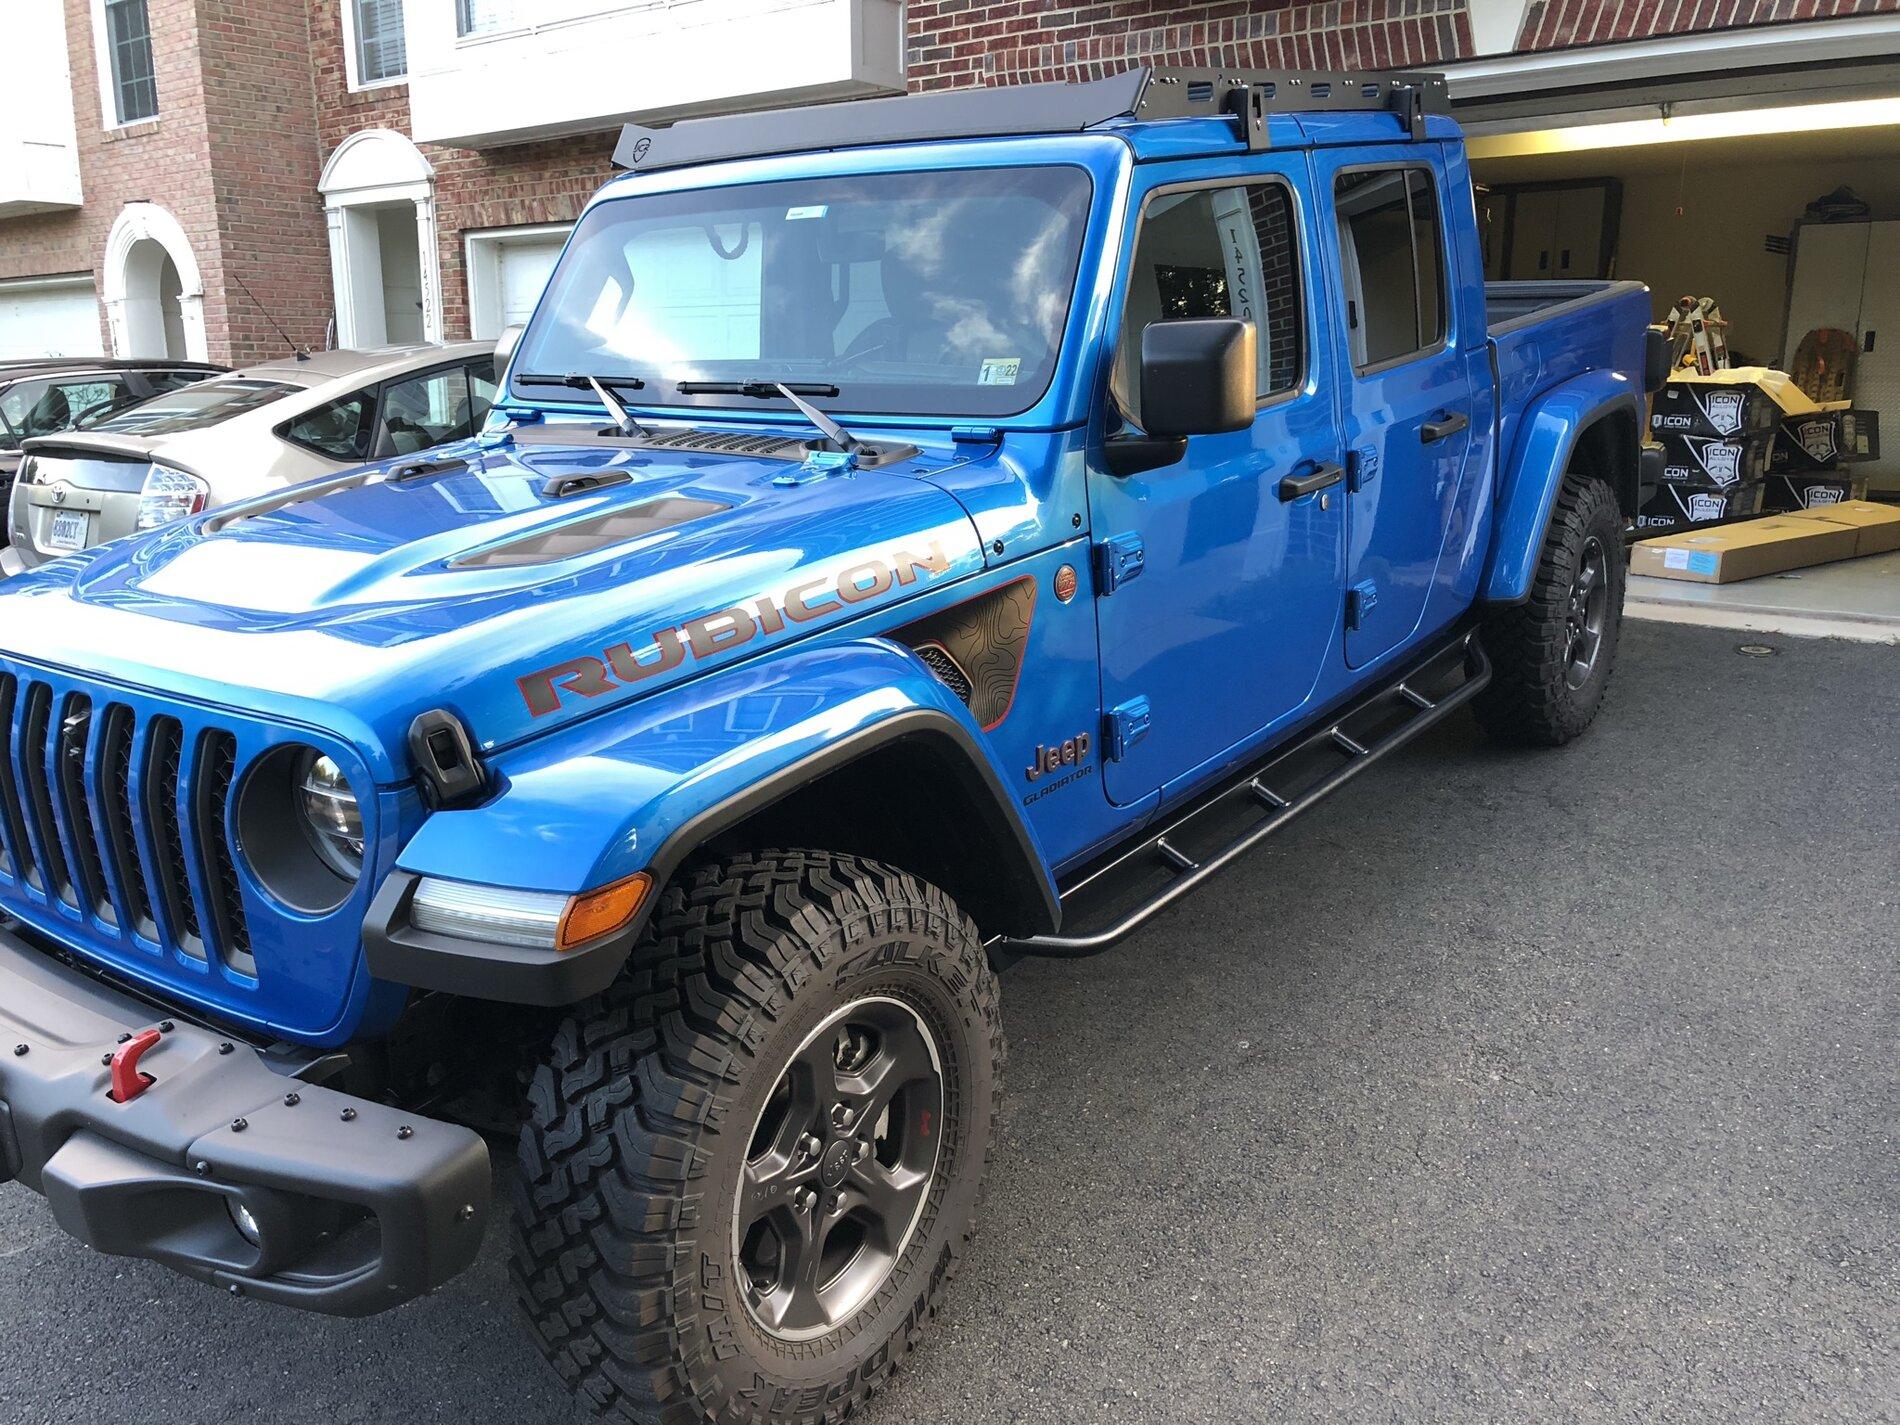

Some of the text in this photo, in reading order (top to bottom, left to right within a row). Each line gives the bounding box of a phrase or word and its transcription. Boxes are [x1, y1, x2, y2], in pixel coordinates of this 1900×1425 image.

[983, 364, 1018, 382] 1 22
[1712, 396, 1738, 404] ICON
[1663, 416, 1692, 426] ICON
[1804, 425, 1829, 435] ICON
[1709, 448, 1736, 457] ICON
[1663, 467, 1689, 477] CON
[1810, 491, 1837, 499] ICON
[1694, 500, 1721, 508] ICON
[1647, 518, 1675, 527] ICON
[515, 539, 951, 718] RUBICON
[1025, 732, 1090, 782] Jeep
[1023, 765, 1093, 807] GLADIATOR
